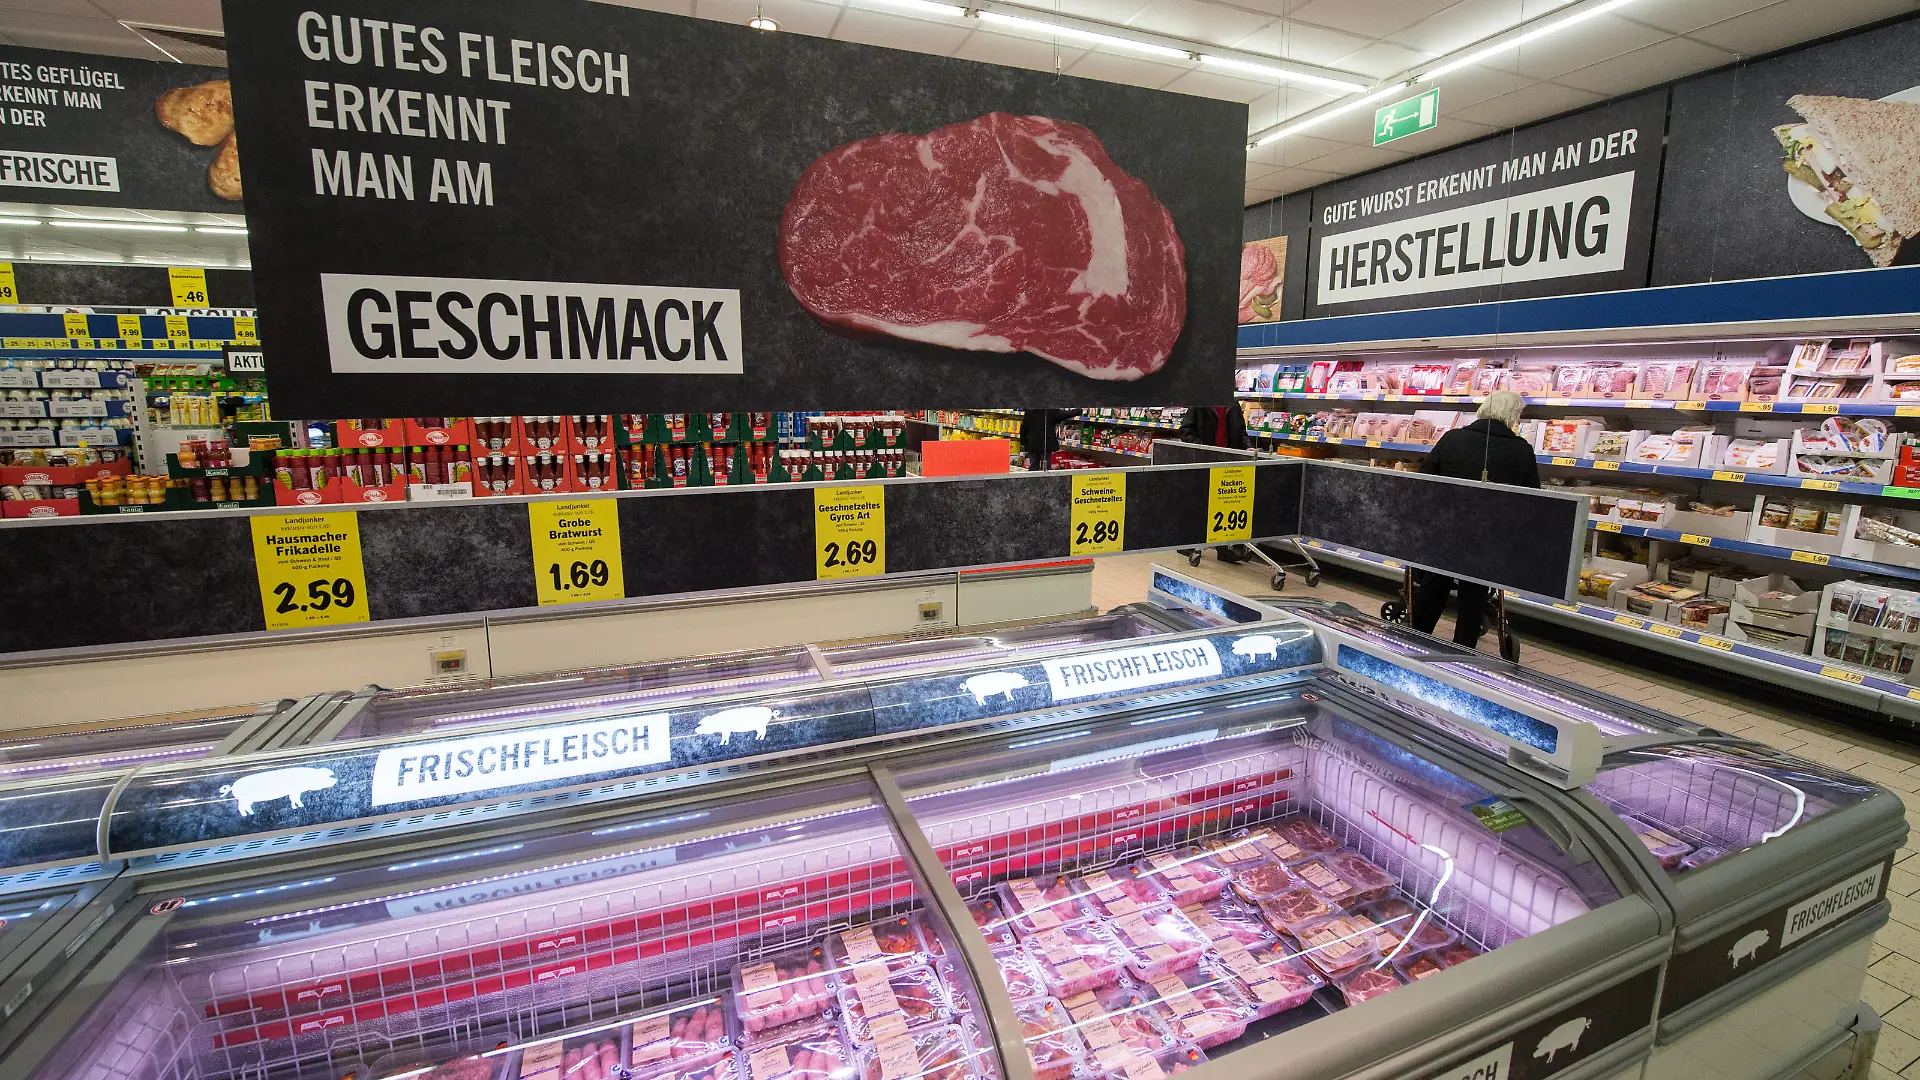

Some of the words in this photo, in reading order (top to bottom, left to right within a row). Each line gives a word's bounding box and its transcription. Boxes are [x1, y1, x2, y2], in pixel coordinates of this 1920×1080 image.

[297, 10, 448, 75] GUTES
[458, 30, 630, 97] FLEISCH
[36, 66, 125, 90] GEFLÜGEL
[63, 90, 102, 110] MAN
[303, 79, 511, 145] ERKENNT
[10, 108, 47, 127] DER
[311, 147, 415, 201] MAN
[428, 157, 494, 206] AM
[1323, 199, 1357, 226] GUTE
[1360, 185, 1412, 217] WURST
[1416, 163, 1497, 205] ERKENNT
[1501, 151, 1546, 184] MAN
[1551, 141, 1582, 171] AN
[1588, 127, 1638, 163] DER
[1328, 195, 1611, 291] HERSTELLUNG
[346, 287, 729, 362] GESCHMACK
[1074, 495, 1123, 505] Geschnetzeltes
[1081, 487, 1116, 496] Schweine-
[1217, 487, 1237, 495] Steaks
[818, 502, 881, 513] Geschnetzeltes
[830, 513, 855, 522] Gyros
[857, 511, 870, 520] Art
[284, 516, 325, 524] Landjunker
[558, 518, 591, 528] Grobe
[1075, 519, 1119, 545] 2.89
[1212, 509, 1248, 533] 2.99
[266, 532, 347, 545] Hausmacher
[549, 528, 602, 540] Bratwurst
[275, 543, 341, 556] Frikadelle
[823, 539, 877, 568] 2.69
[548, 559, 609, 591] 1.69
[273, 577, 355, 615] 2.59
[1058, 647, 1209, 688] FRISCHFLEISCH
[397, 724, 649, 787] FRISCHFLEISCH
[1790, 874, 1876, 935] FRISCHFLEISCH
